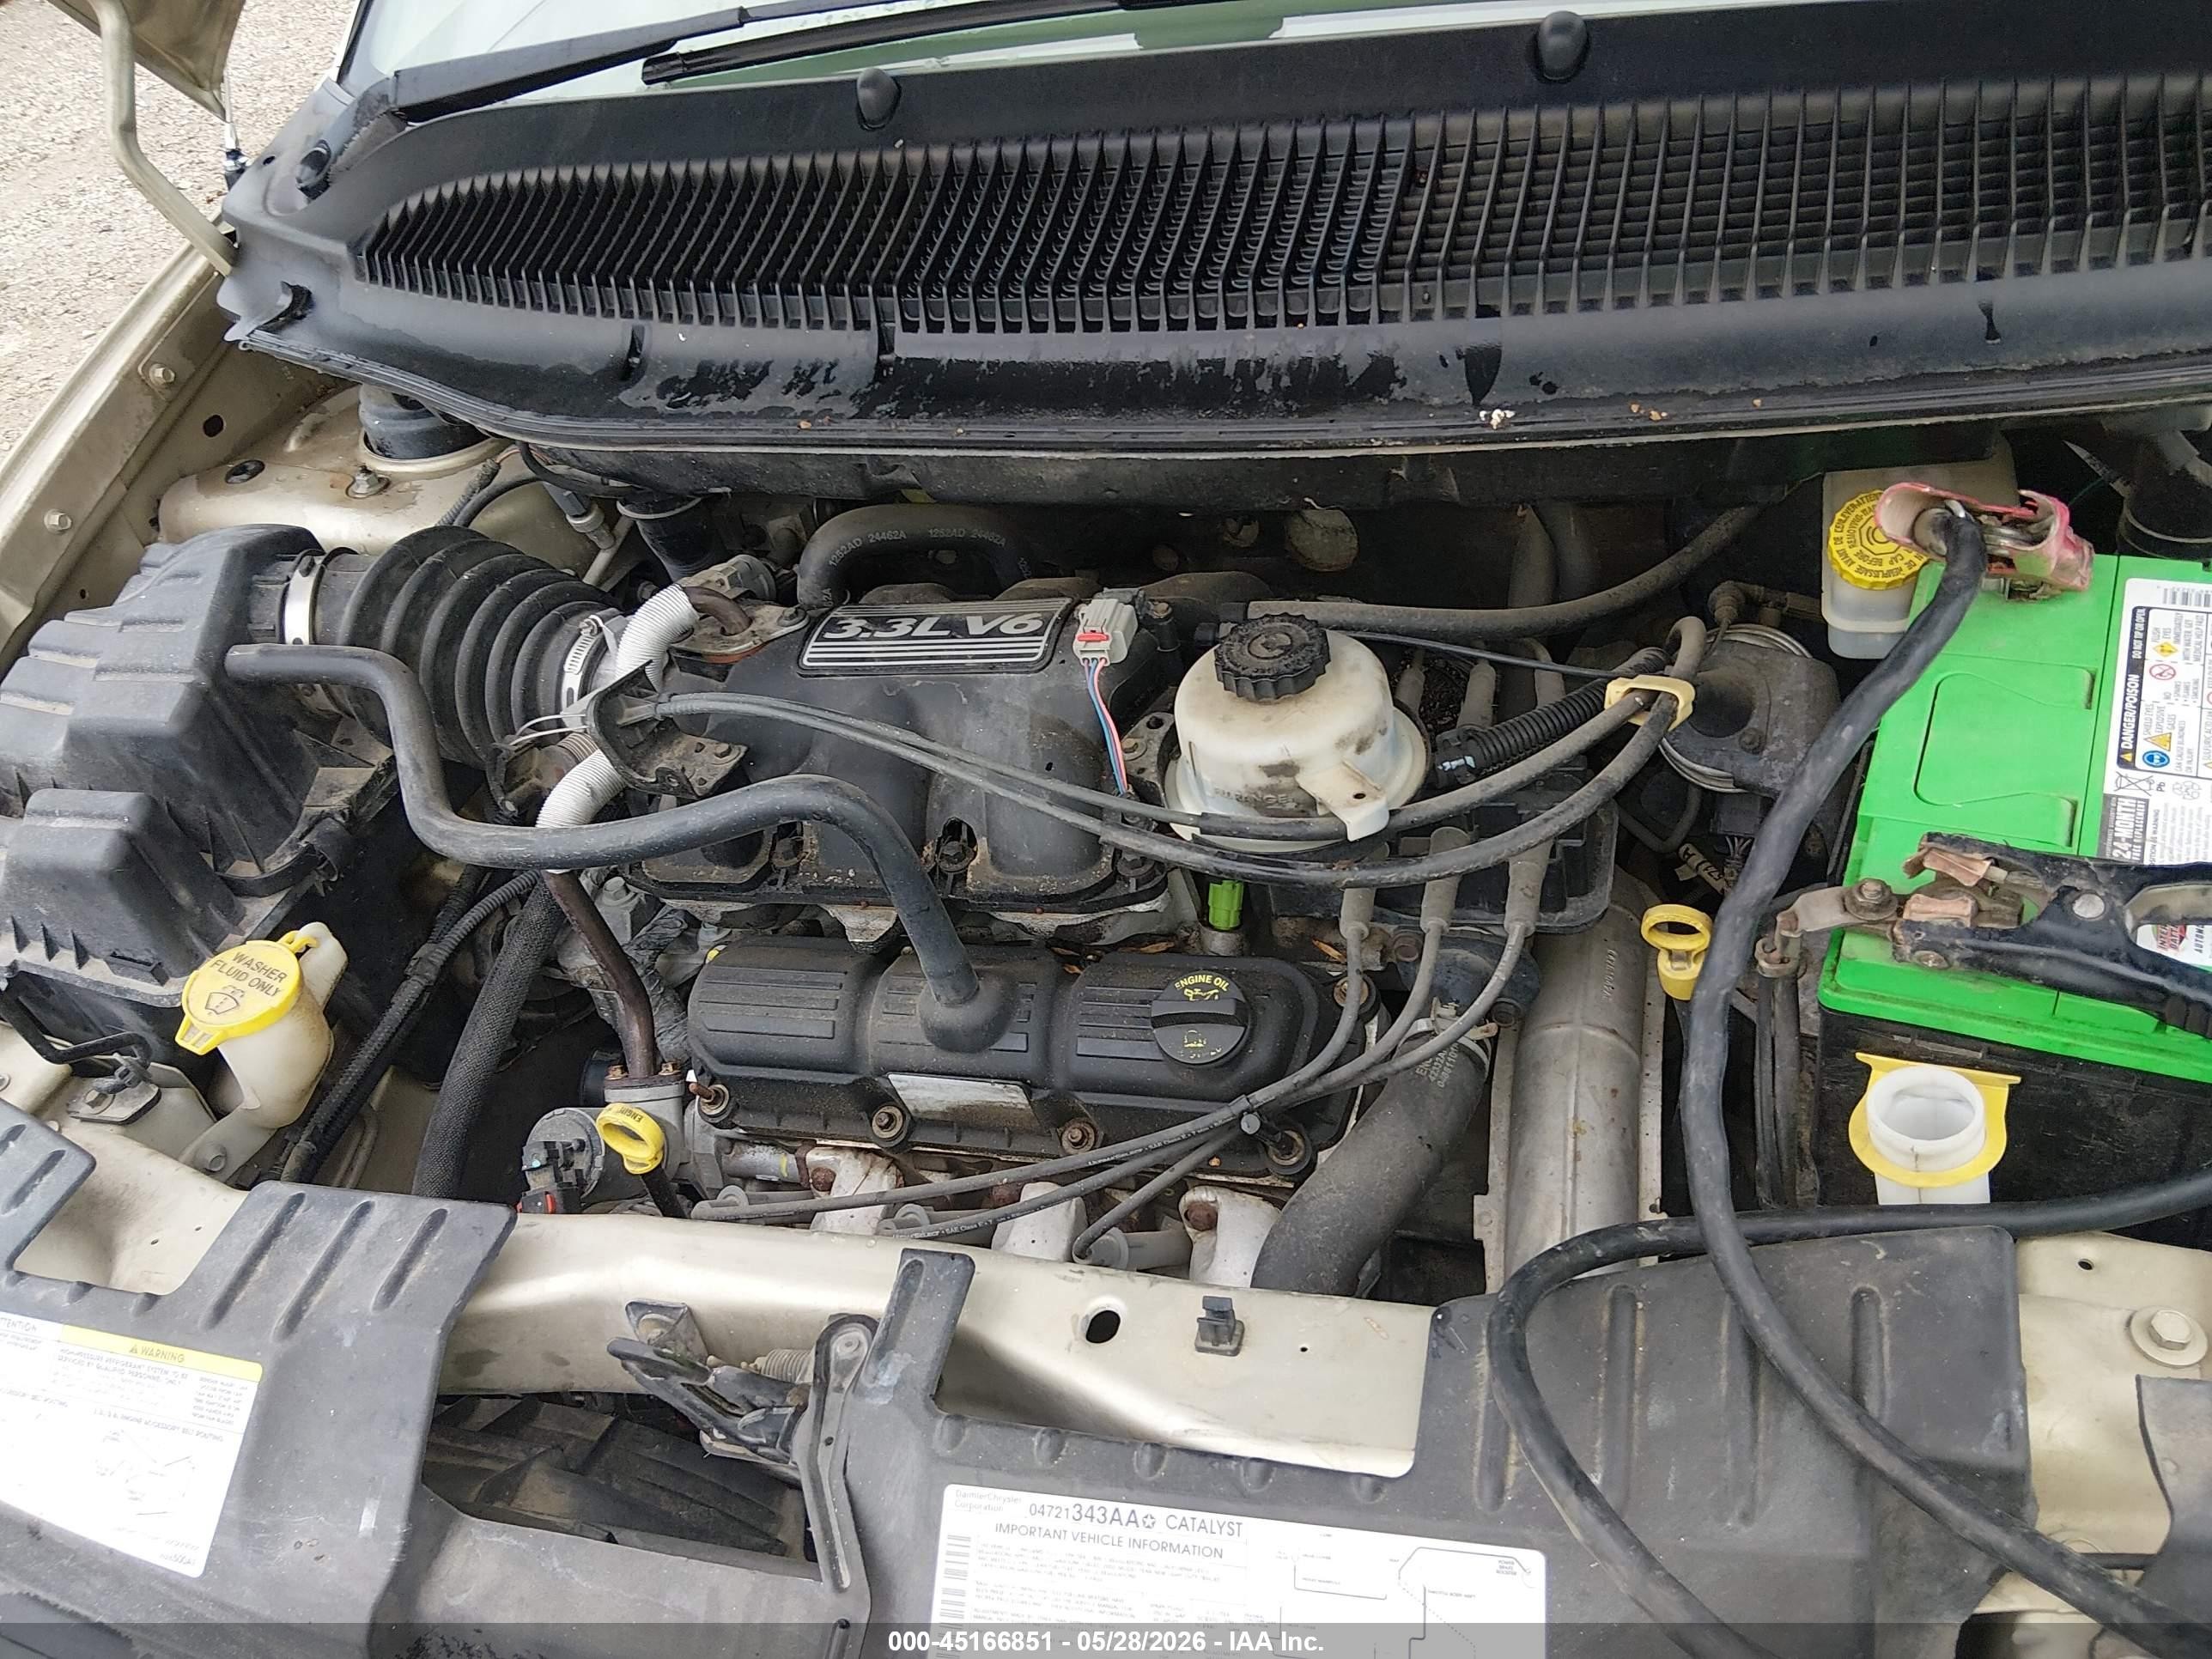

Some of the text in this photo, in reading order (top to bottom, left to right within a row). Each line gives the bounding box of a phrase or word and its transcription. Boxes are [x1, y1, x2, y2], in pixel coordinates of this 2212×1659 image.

[1833, 536, 1844, 545] DE
[1836, 549, 1856, 567] AVANT
[1853, 550, 1883, 567] BEFORE
[1888, 553, 1905, 565] CAP
[1855, 564, 1905, 578] REMPLISSAGE
[823, 613, 1043, 639] 3.3L V6
[2133, 640, 2142, 649] NOT
[2121, 674, 2139, 749] DANGER/POISON
[2156, 781, 2166, 792] Pb
[2112, 798, 2136, 859] 24-MONTH
[2133, 800, 2147, 842] REPLACEMENT
[233, 951, 288, 983] WASHER
[210, 959, 282, 997] FLUID ONLY
[1174, 975, 1230, 992] ENGINE OIL
[0, 1317, 37, 1333] TTENTION
[141, 1346, 185, 1364] WARNING
[955, 1490, 1022, 1504] DaimlerChrysler
[954, 1500, 1004, 1513] Corporation
[1030, 1503, 1243, 1537] 04721343AA CATALYST
[995, 1522, 1224, 1559] IMPORTANT VEHICLE INFORMATION
